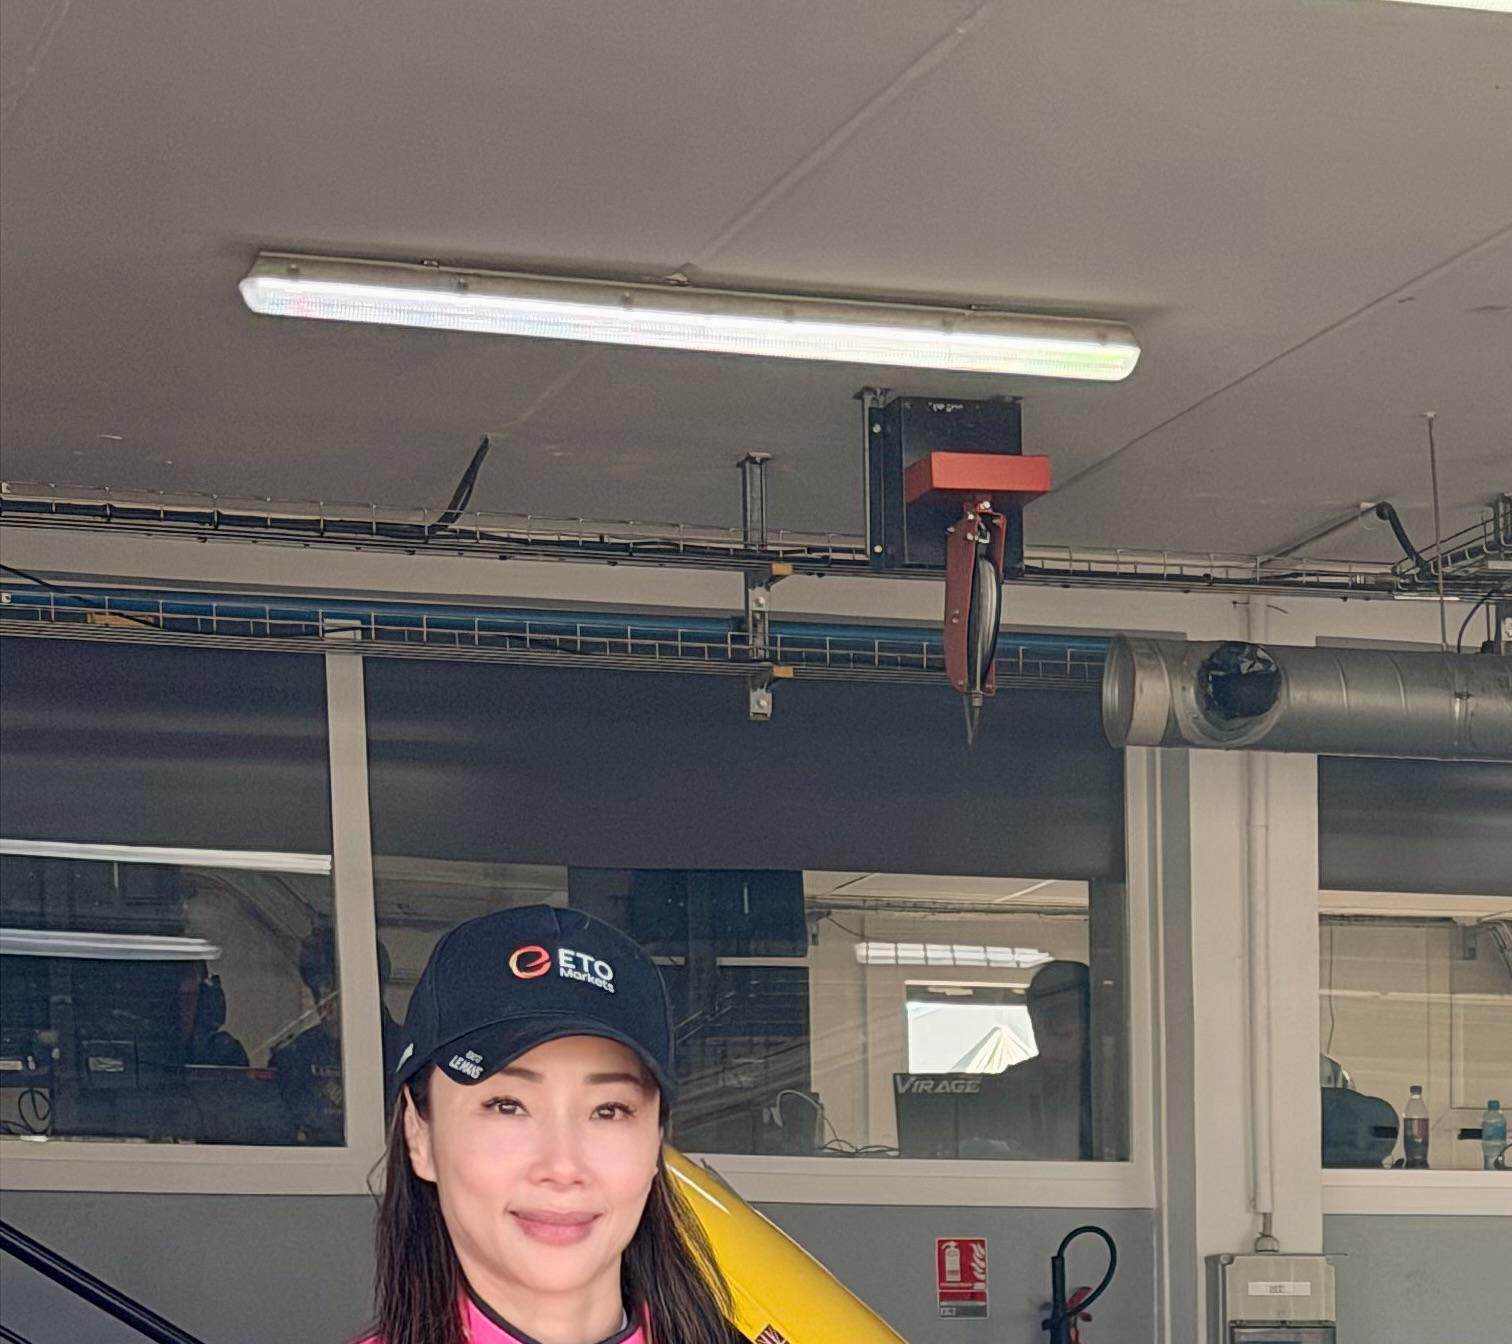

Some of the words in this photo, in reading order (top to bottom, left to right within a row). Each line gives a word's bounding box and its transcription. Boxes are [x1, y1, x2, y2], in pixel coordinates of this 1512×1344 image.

[558, 948, 614, 981] ETO
[559, 966, 616, 994] Markets
[896, 1075, 981, 1094] VIRAGE
